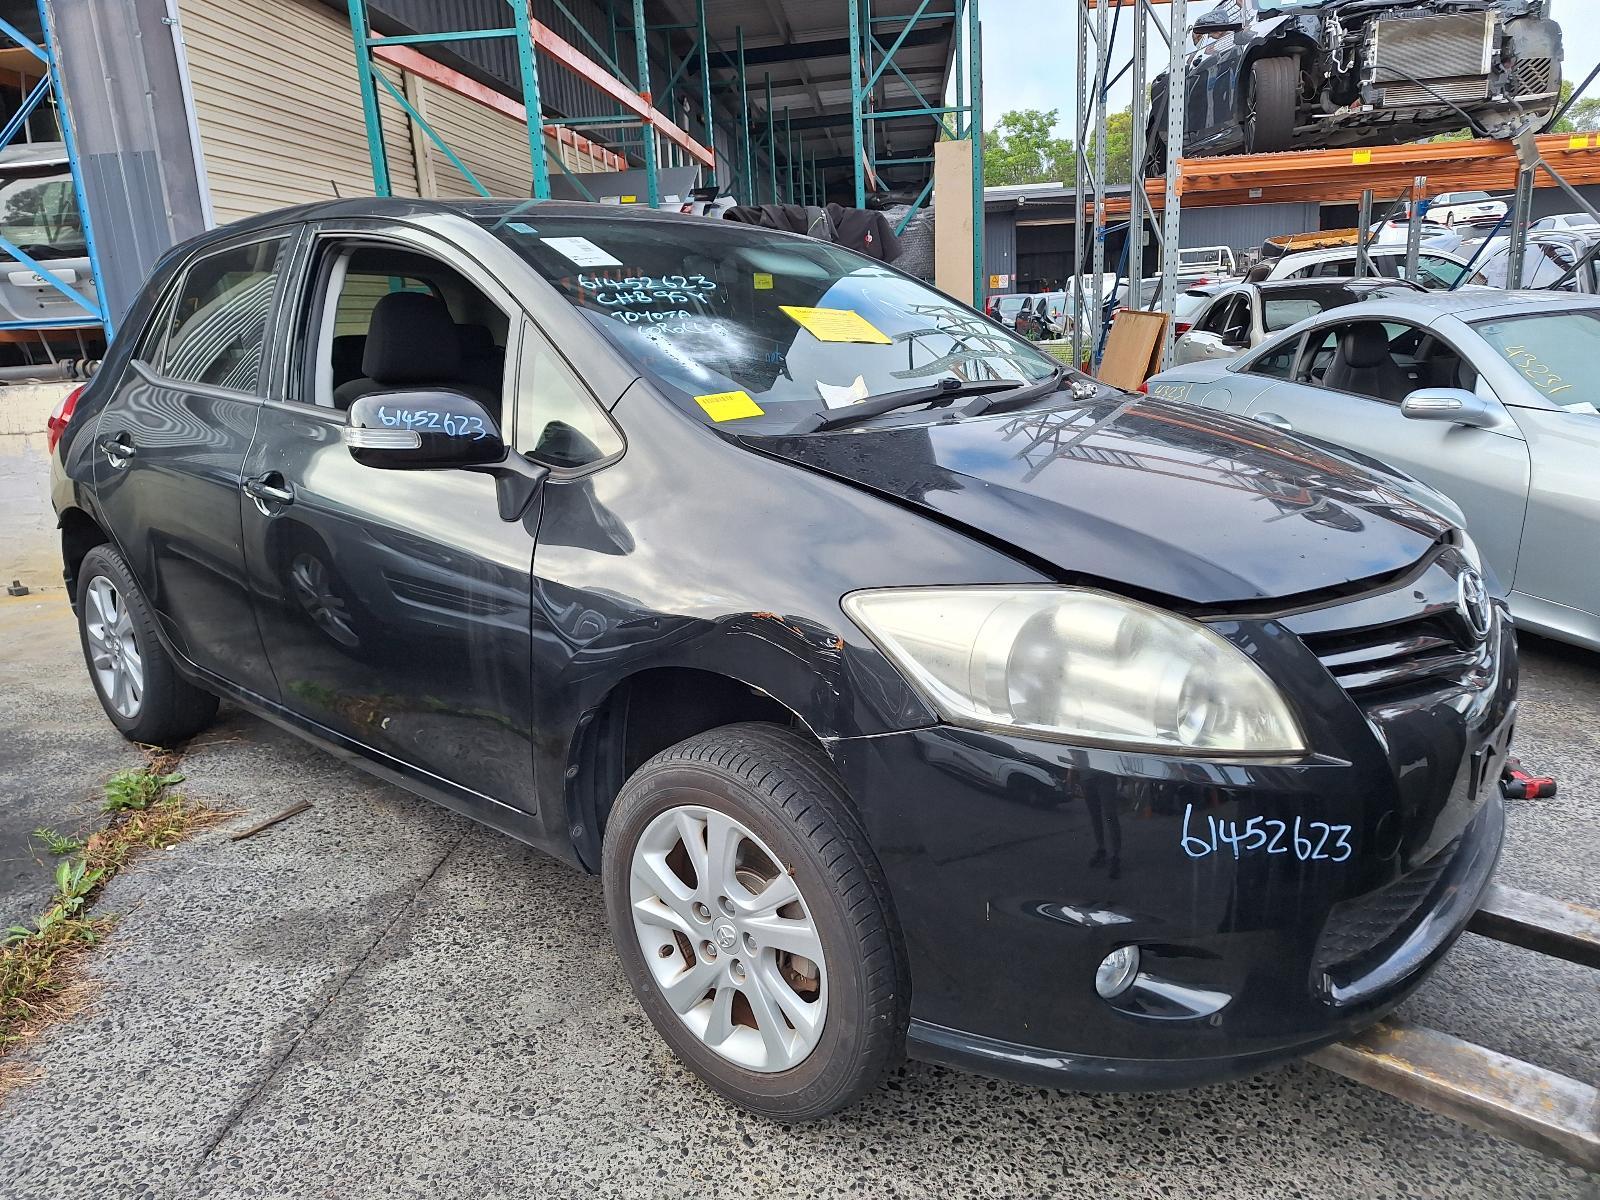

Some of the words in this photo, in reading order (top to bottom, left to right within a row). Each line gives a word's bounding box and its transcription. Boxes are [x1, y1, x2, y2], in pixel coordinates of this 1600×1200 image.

[578, 273, 717, 290] 61452623
[611, 309, 692, 325] TOYOTA
[1504, 345, 1573, 394] 43231
[1154, 383, 1194, 401] 43231
[378, 406, 487, 441] 61452623
[1180, 803, 1352, 862] 61452623
